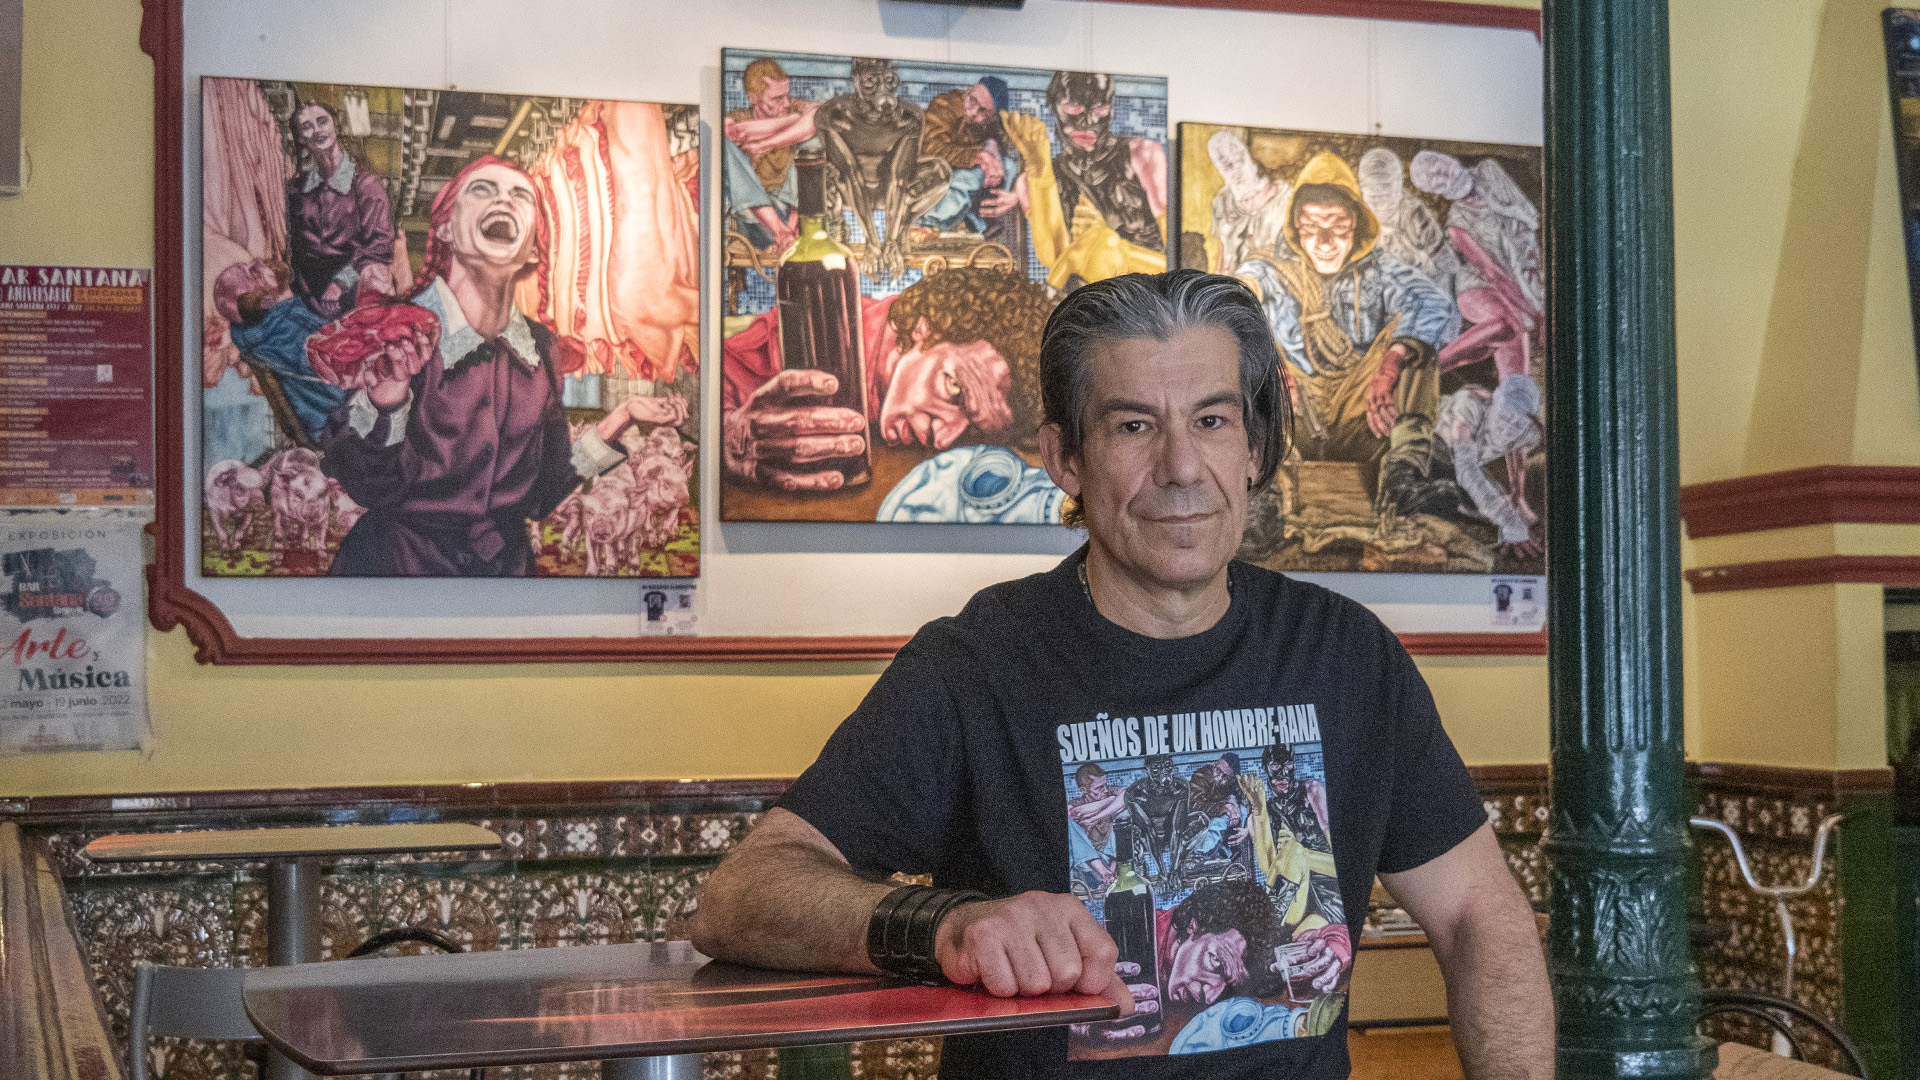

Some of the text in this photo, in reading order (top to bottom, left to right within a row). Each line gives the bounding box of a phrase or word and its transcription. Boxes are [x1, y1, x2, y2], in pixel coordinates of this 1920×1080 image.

[38, 268, 143, 287] SANTANA
[8, 529, 106, 541] EXPOSICIÓN
[19, 582, 40, 591] BAR
[19, 593, 84, 608] Santana
[0, 627, 90, 666] Arte
[18, 665, 131, 691] Música
[10, 700, 44, 710] mayo
[68, 696, 98, 708] junio
[101, 694, 131, 705] 2022
[1057, 703, 1322, 763] SUEÑOS DE UN HOMBRE-RANA
